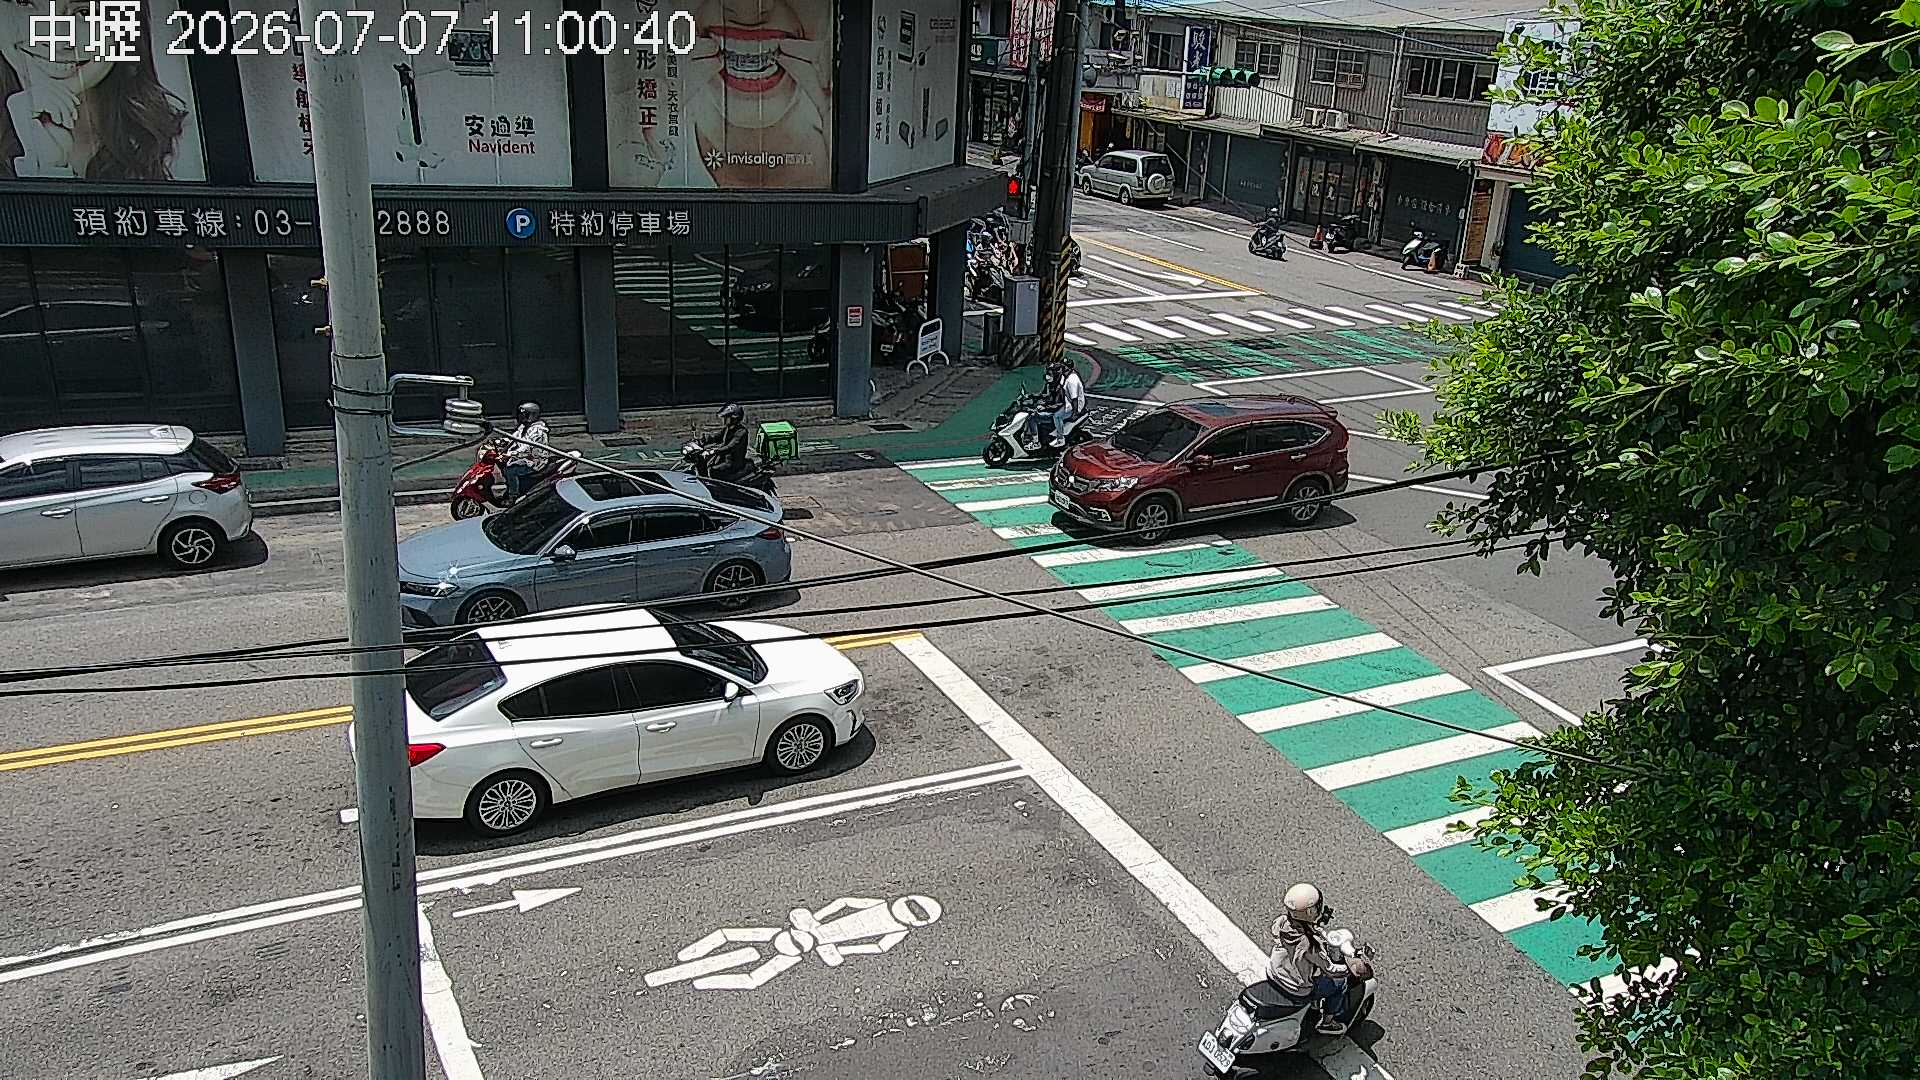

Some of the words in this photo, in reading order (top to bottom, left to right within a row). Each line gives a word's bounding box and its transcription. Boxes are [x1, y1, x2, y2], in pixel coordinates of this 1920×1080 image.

[468, 139, 536, 156] Navident
[550, 209, 692, 238] 特約停車場
